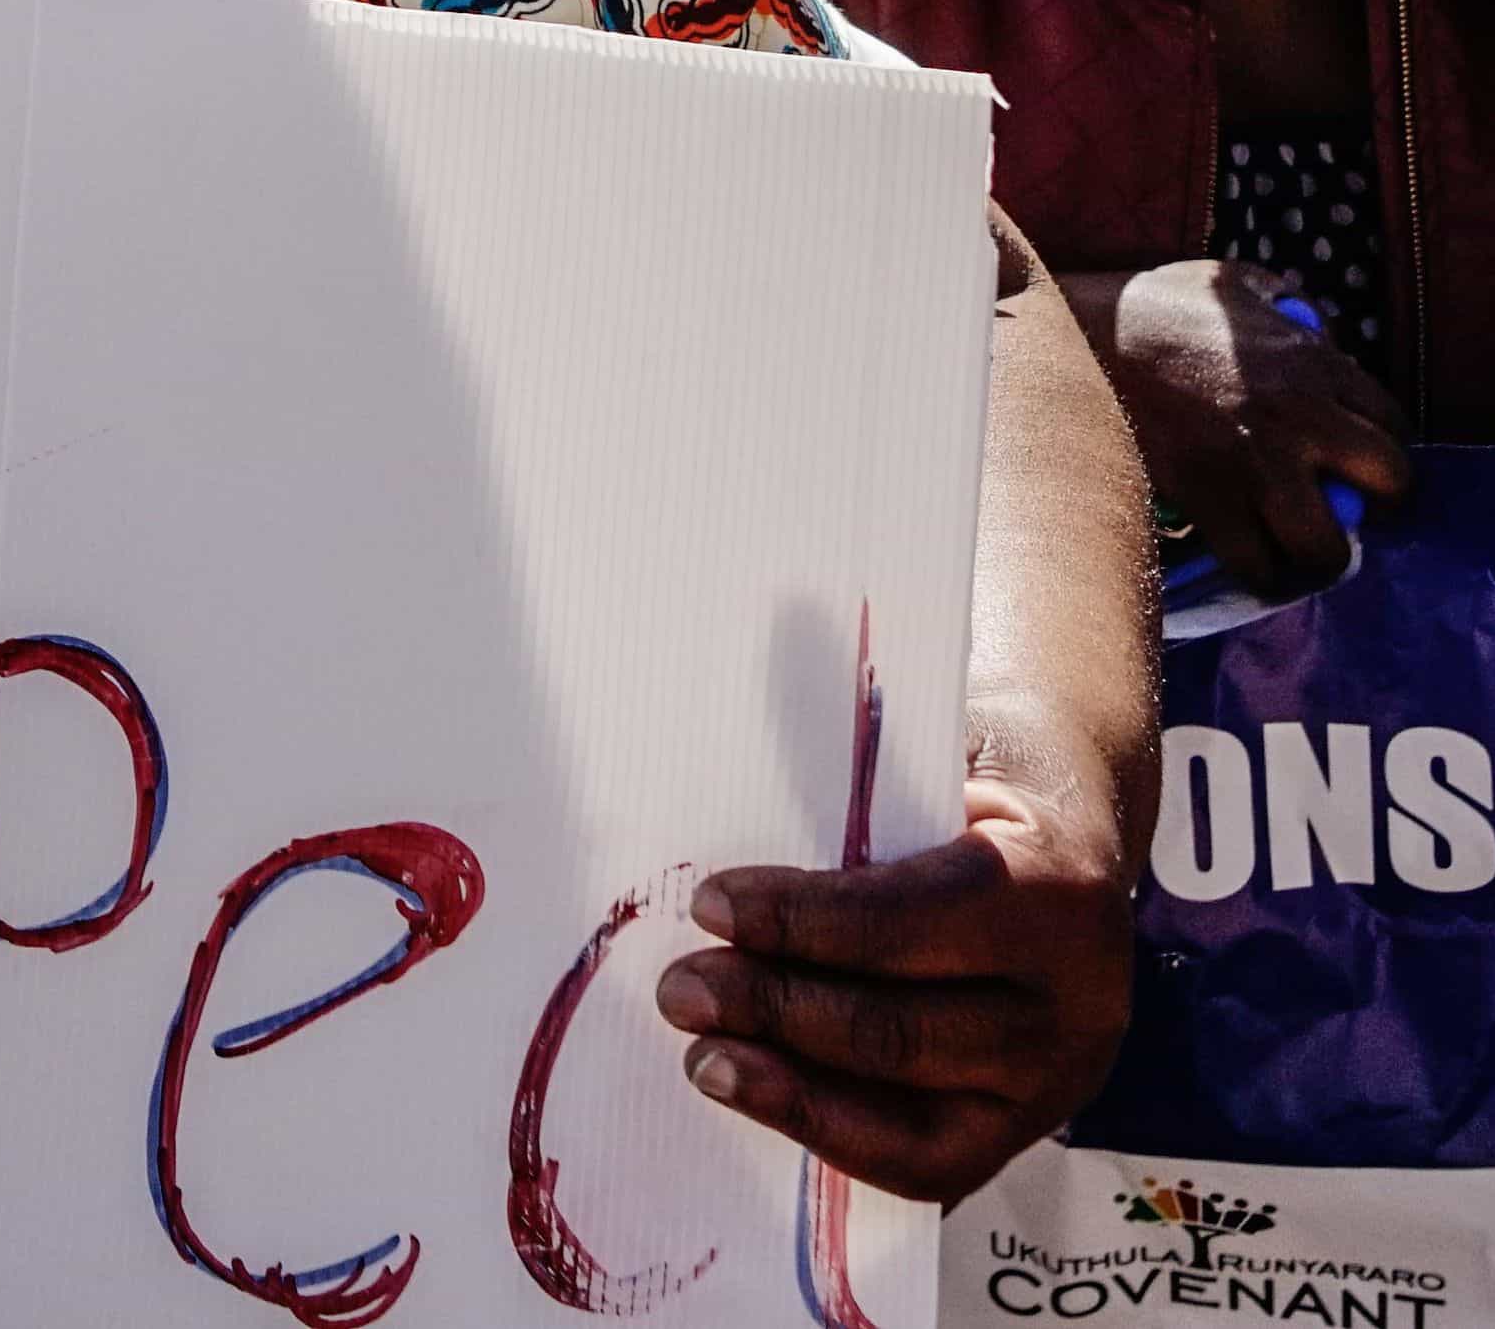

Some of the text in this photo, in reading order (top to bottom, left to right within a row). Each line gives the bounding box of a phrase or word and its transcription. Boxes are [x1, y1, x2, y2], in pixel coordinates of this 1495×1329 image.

[988, 1230, 1447, 1292] UKUTHULA RUNYARARO
[986, 1267, 1447, 1329] COVENANT
